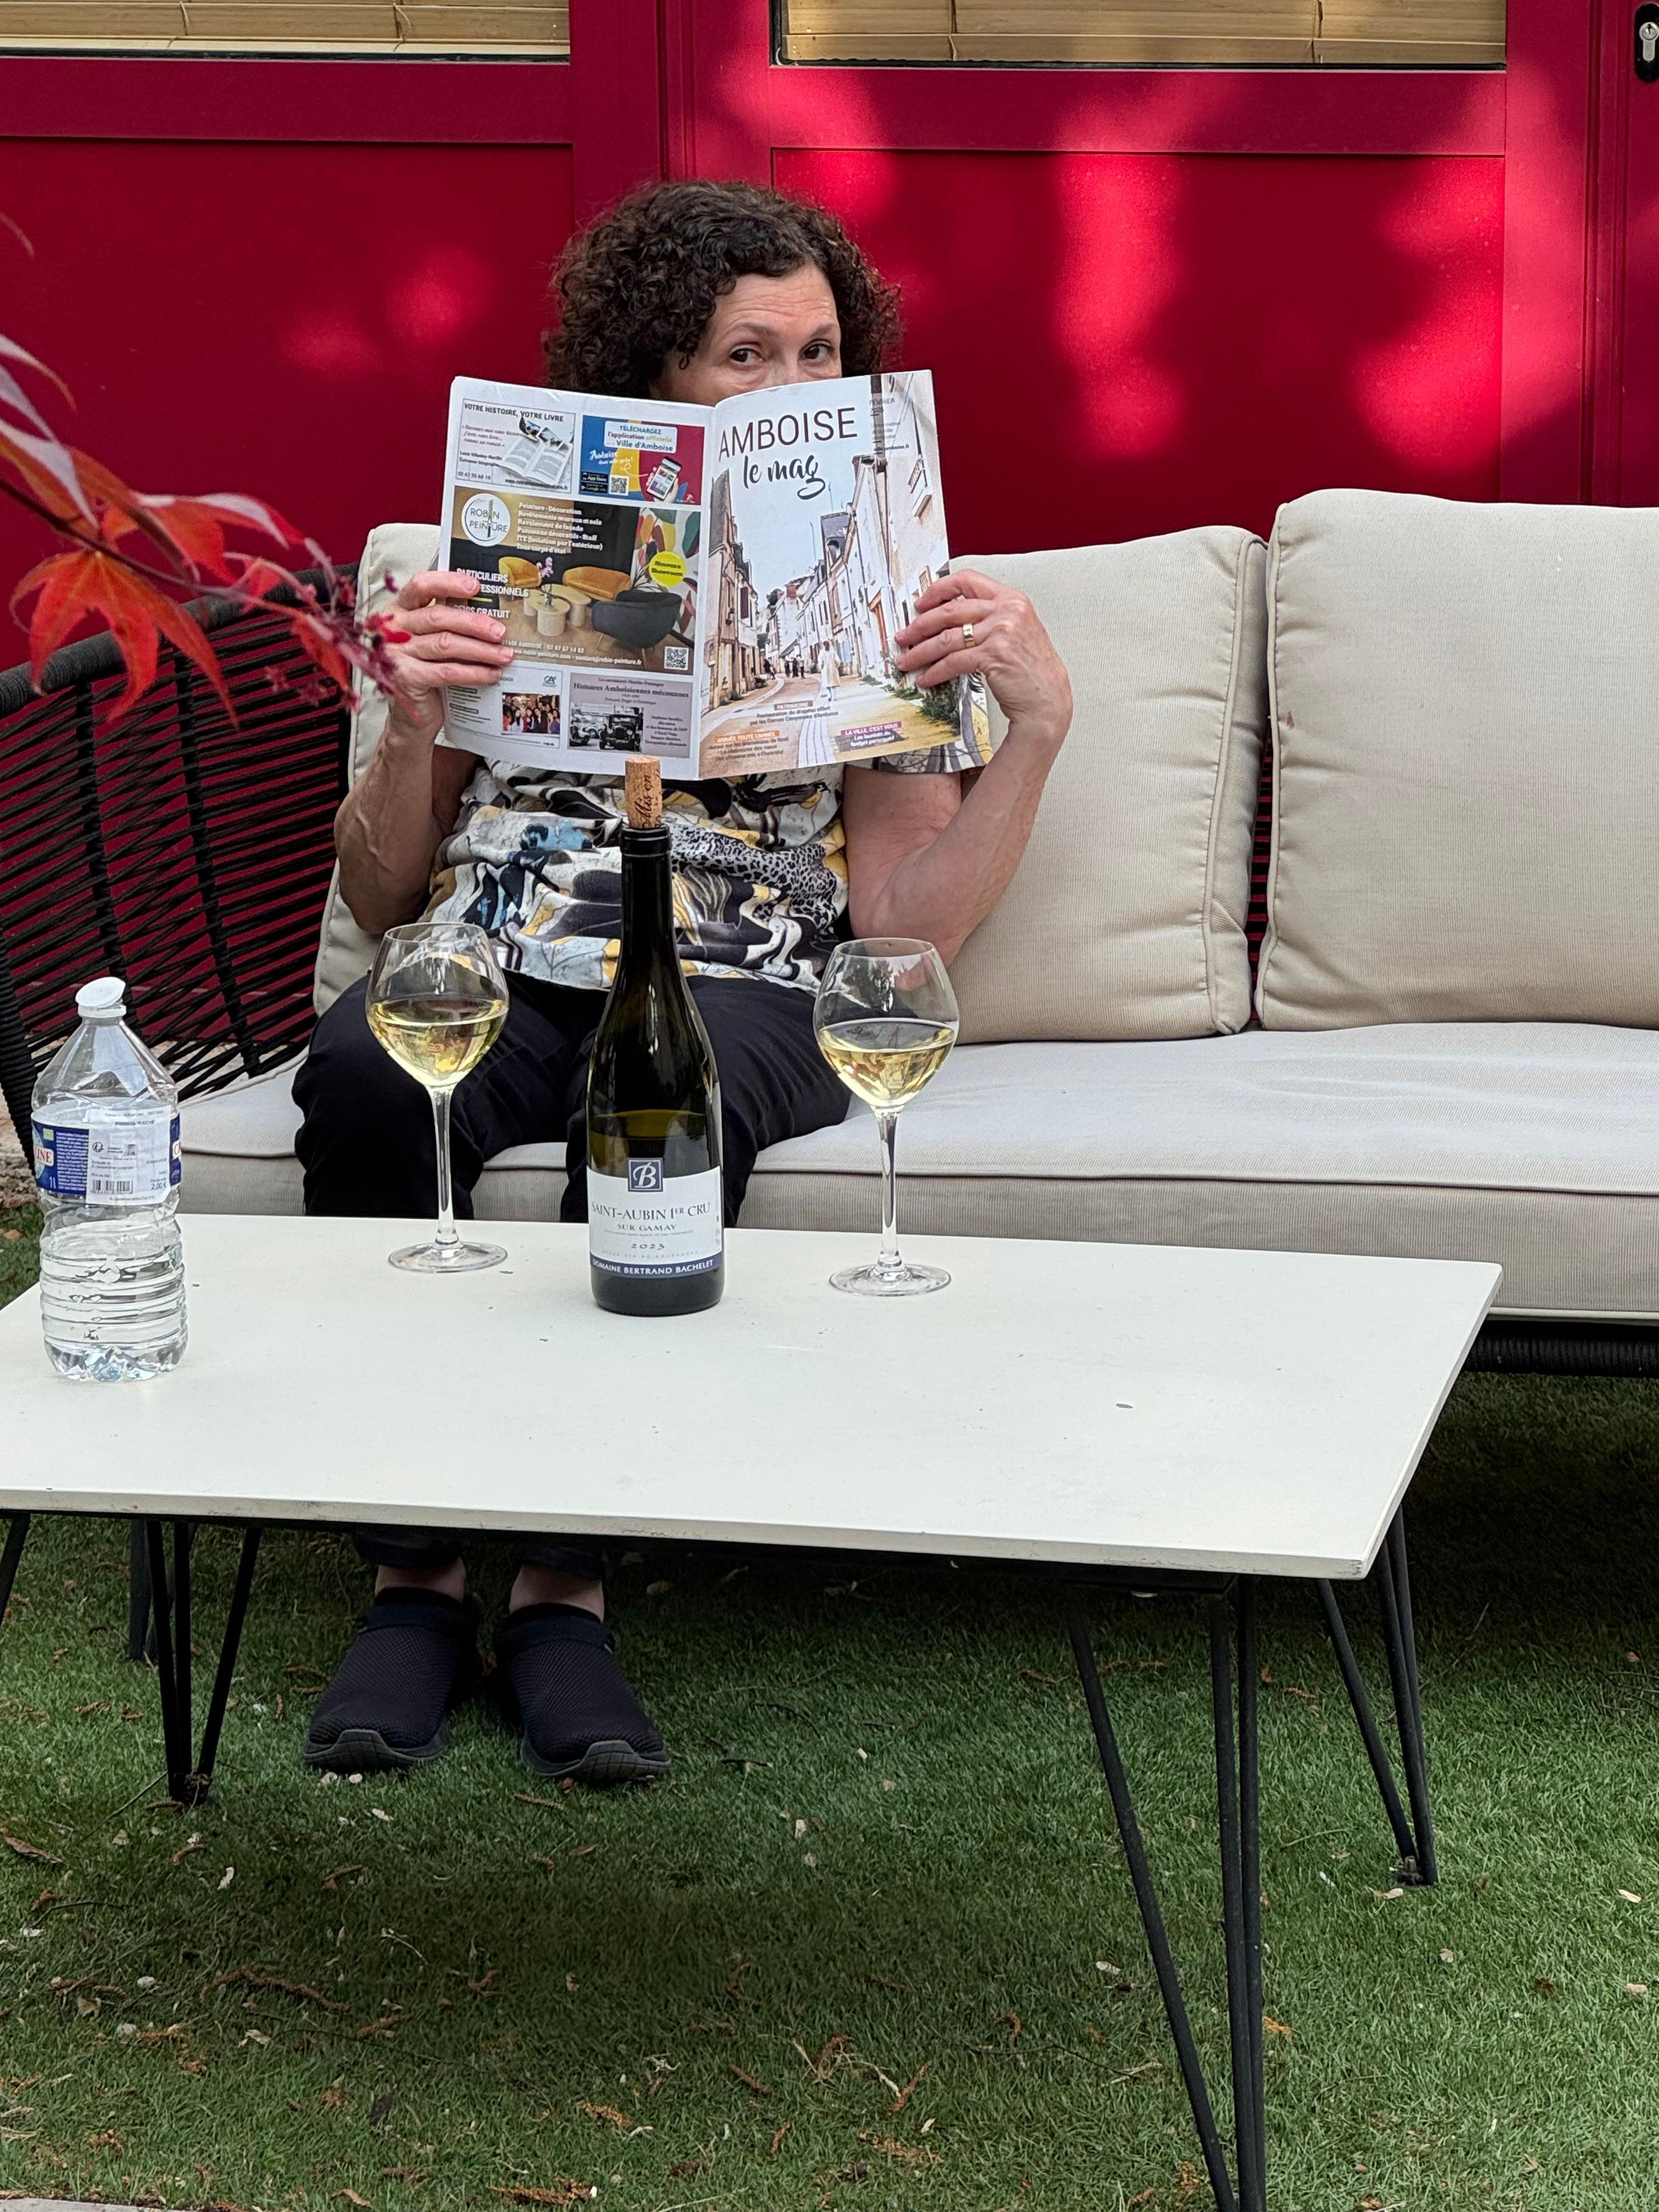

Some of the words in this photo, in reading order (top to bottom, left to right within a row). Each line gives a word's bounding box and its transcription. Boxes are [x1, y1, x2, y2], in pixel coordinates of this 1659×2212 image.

[464, 403, 484, 412] VOTRE
[485, 407, 518, 417] HISTOIRE,
[521, 411, 543, 420] VOTRE
[544, 414, 563, 422] LIVRE
[608, 432, 645, 440] l'application
[619, 425, 662, 435] TÉLÉCHARGEZ
[719, 407, 857, 461] AMBOISE
[635, 442, 673, 452] d'Amboise
[743, 455, 761, 489] le
[768, 455, 826, 500] mag
[470, 508, 499, 519] ROBIN
[518, 502, 545, 511] Peinture
[548, 506, 582, 515] Décoration
[470, 521, 507, 533] PEINTURE
[518, 519, 554, 529] Ravalement
[517, 527, 548, 537] Panneaux
[654, 561, 681, 569] Nouveau
[456, 568, 508, 583] PARTICULIERS
[651, 567, 683, 576] Showroom
[479, 584, 529, 597] ESSIONNELS
[476, 608, 510, 619] GRATUIT
[574, 682, 603, 691] Histoires
[644, 774, 653, 791] en
[633, 1162, 656, 1188] B
[592, 1201, 666, 1220] SAINT-AUBIN
[687, 1202, 710, 1216] CRU
[592, 1259, 621, 1273] DOMAINE
[624, 1266, 673, 1274] BERTRAND
[675, 1259, 714, 1273] BACHELET
